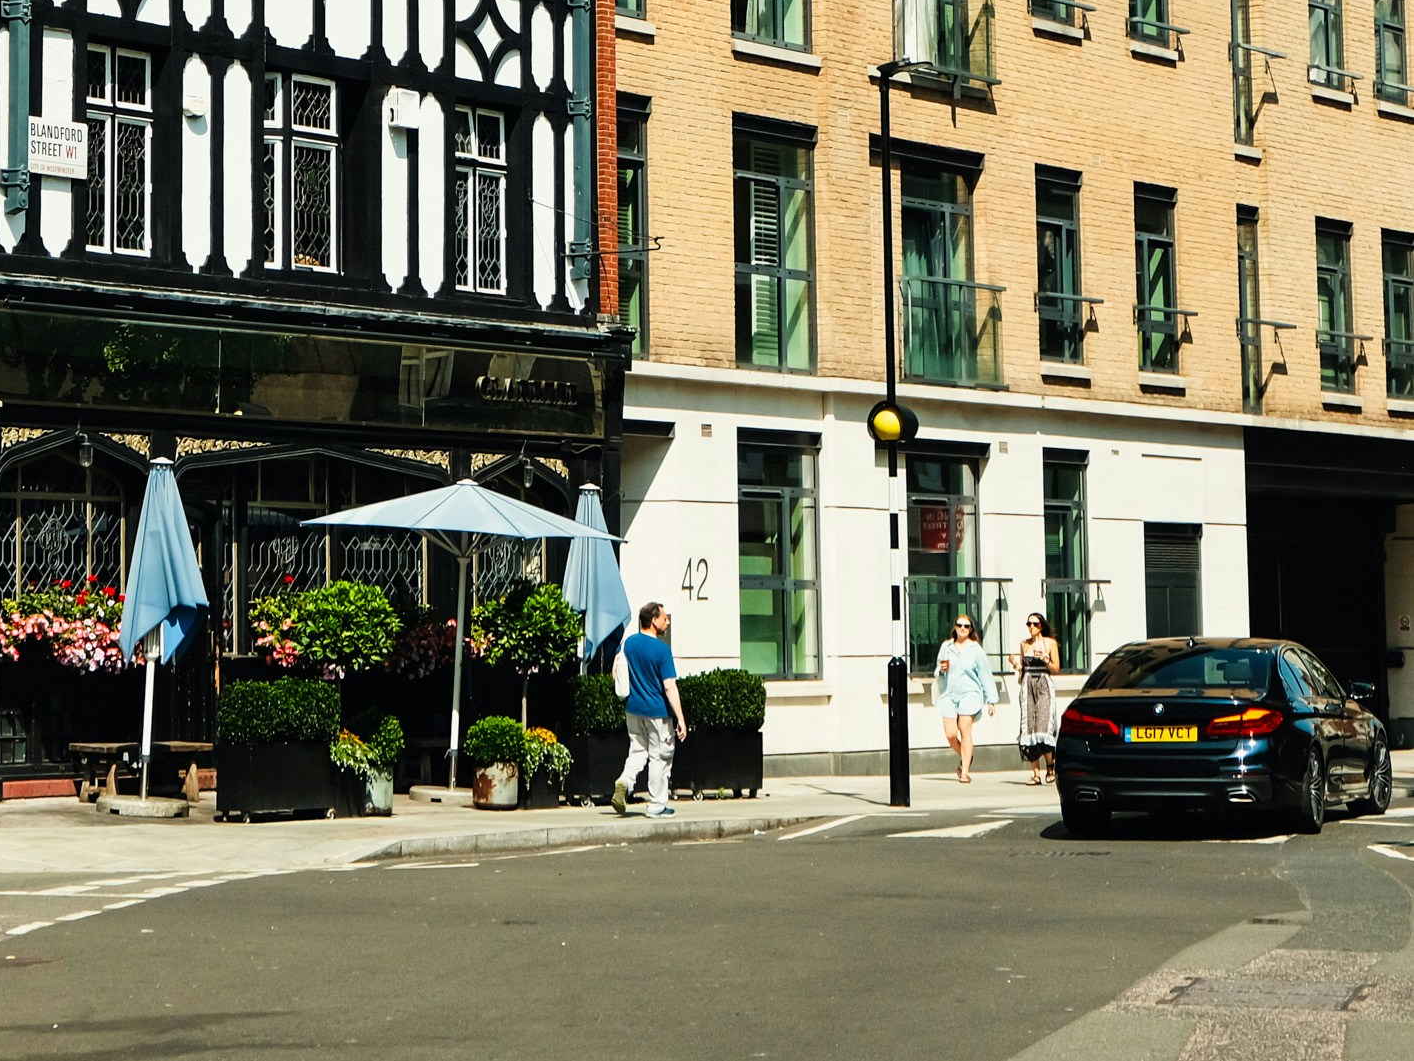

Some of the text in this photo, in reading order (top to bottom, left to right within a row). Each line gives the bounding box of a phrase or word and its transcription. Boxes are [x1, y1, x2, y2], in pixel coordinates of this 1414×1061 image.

[30, 122, 83, 143] BLANDFORD
[30, 140, 77, 160] STREET W1
[681, 557, 709, 601] 42
[1136, 727, 1193, 739] LG17 VCT
